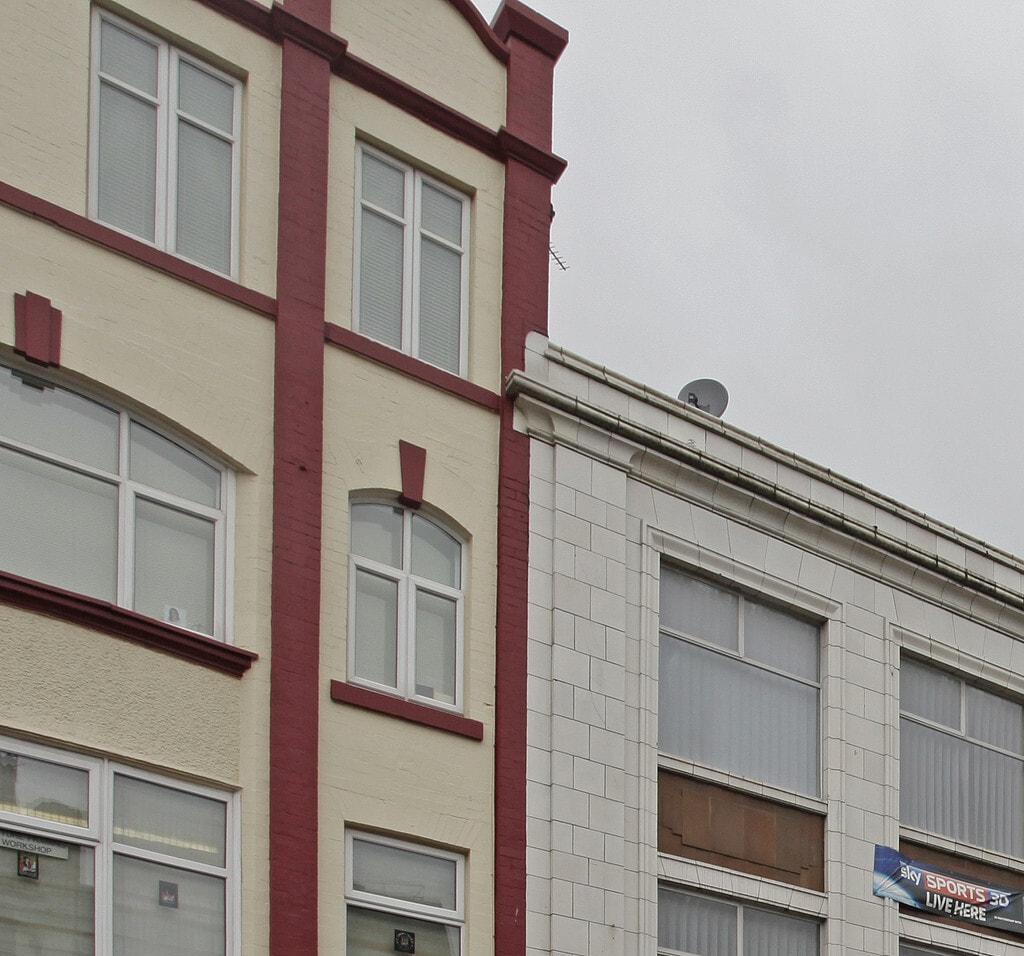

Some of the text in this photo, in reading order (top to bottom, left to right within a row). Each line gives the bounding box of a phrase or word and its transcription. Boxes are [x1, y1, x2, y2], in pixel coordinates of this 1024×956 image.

[2, 839, 53, 854] WORKSHOP
[900, 865, 921, 886] sky
[926, 875, 986, 903] SPORTS
[925, 891, 953, 913] LIVE
[953, 901, 987, 921] HERE
